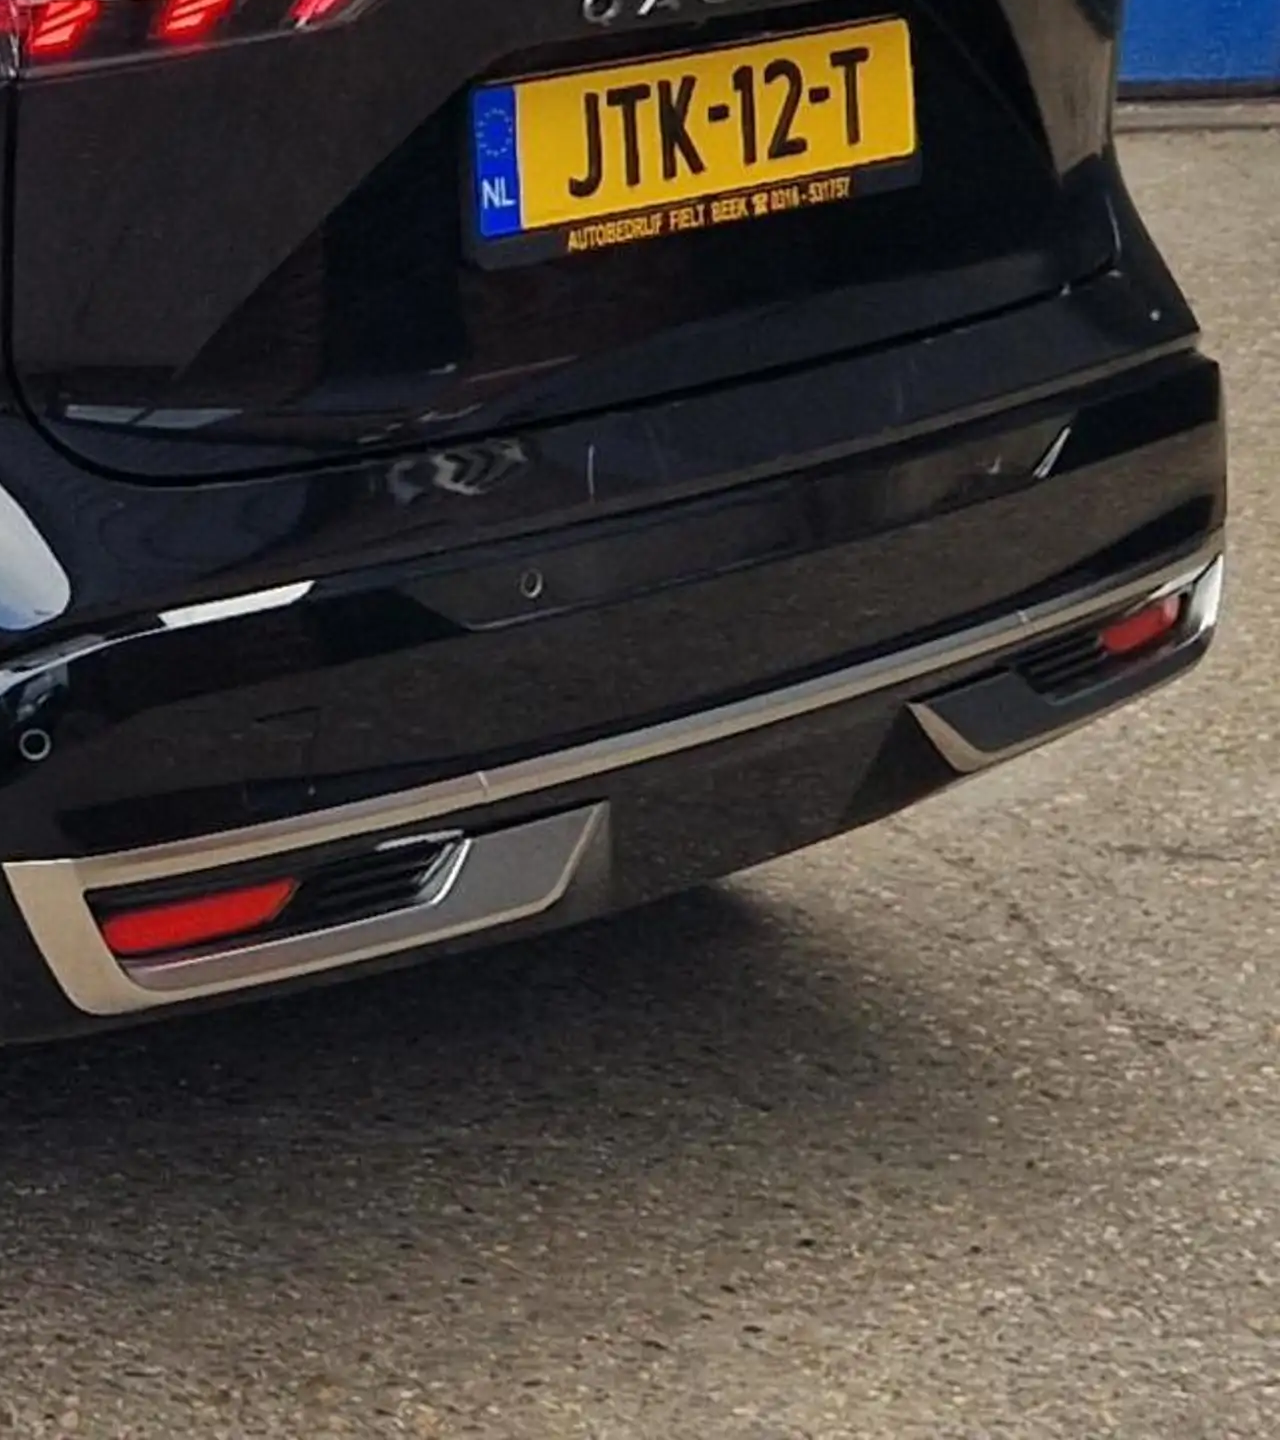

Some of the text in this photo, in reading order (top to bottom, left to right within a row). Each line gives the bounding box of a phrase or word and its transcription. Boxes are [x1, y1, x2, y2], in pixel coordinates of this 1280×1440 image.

[568, 46, 870, 200] JTK-12-T
[481, 177, 517, 210] NL
[567, 212, 663, 253] AUTOBEDRIJF
[710, 196, 750, 223] BEEK
